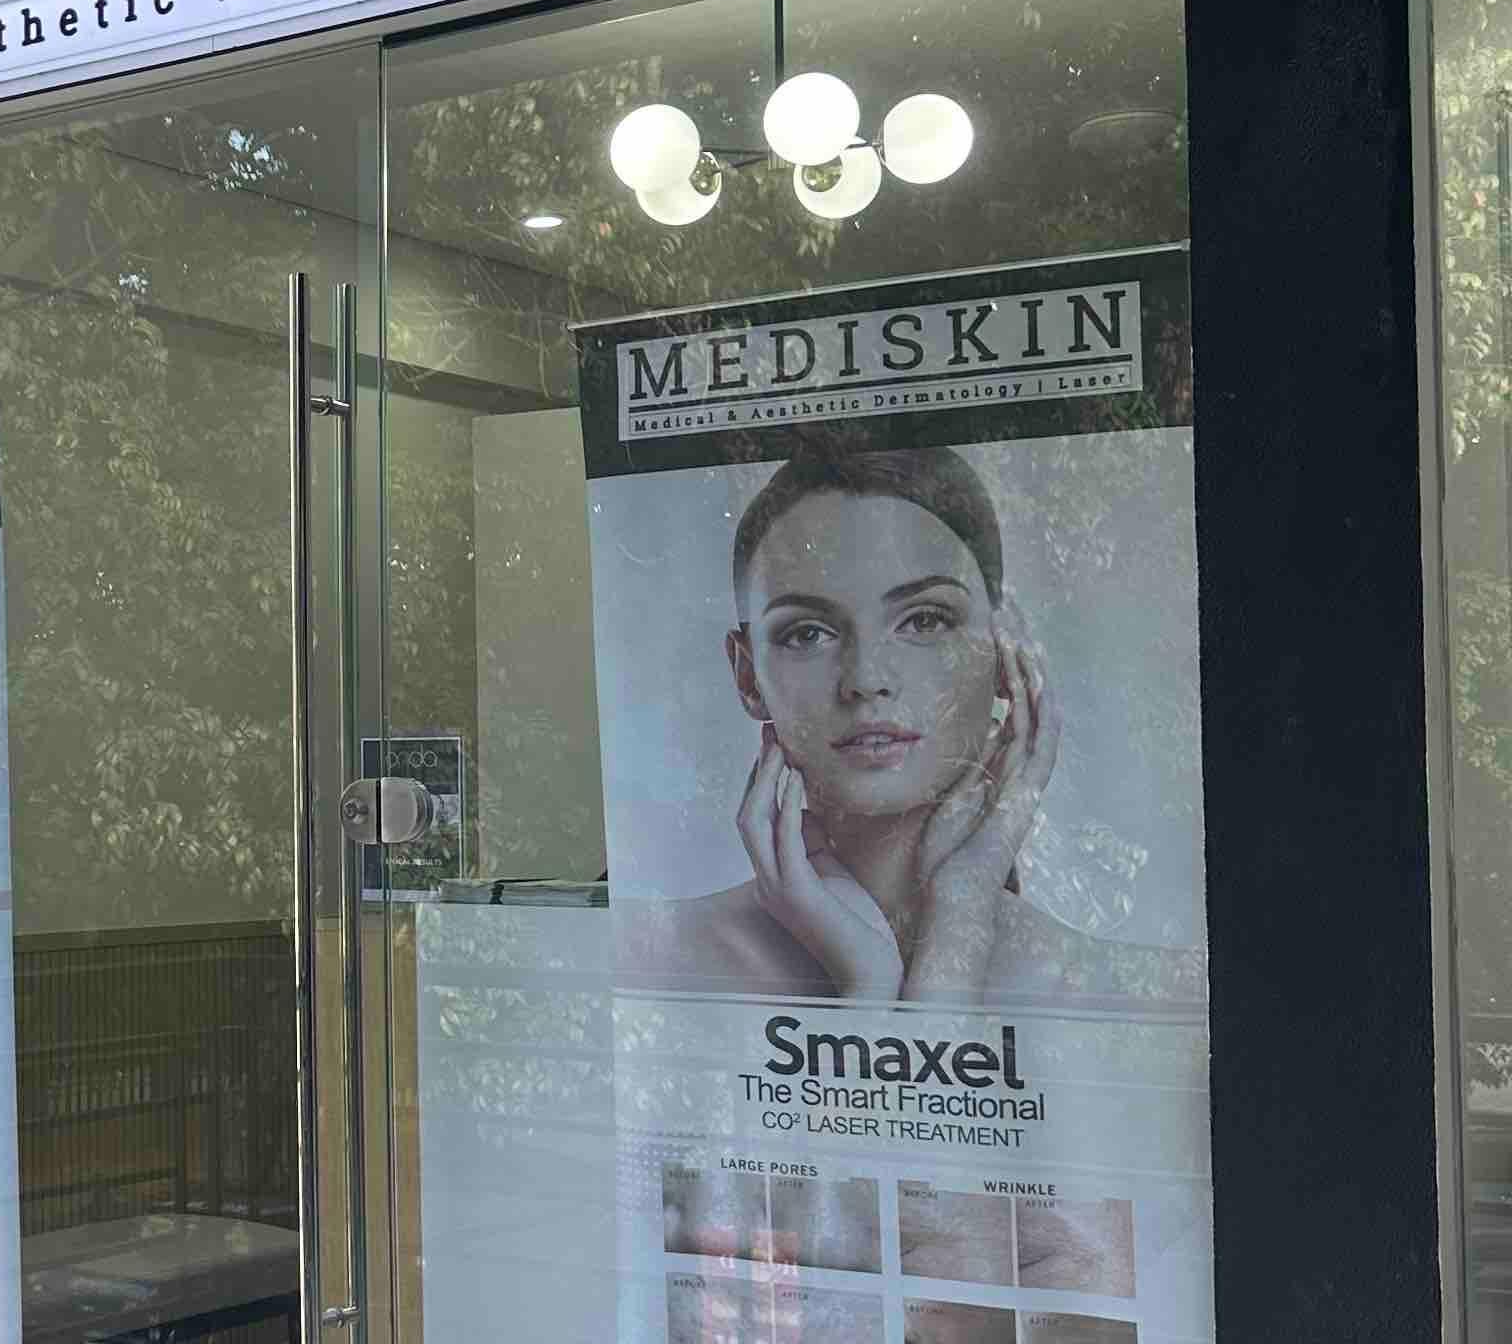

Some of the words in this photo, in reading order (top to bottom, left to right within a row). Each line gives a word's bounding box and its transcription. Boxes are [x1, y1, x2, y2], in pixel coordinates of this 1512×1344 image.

[628, 289, 1126, 400] MEDISKIN
[634, 411, 715, 432] Medical
[751, 397, 860, 420] Aesthetic
[873, 382, 1022, 407] Dermatology
[1058, 372, 1128, 390] Laser
[764, 1015, 1025, 1090] Smaxel
[737, 1073, 792, 1104] The
[800, 1079, 889, 1112] Smart
[897, 1084, 1046, 1121] Fractional
[807, 1114, 881, 1137] LASER
[885, 1119, 1025, 1148] TREATMENT
[720, 1157, 765, 1174] LARGE
[770, 1161, 819, 1178] PORES
[983, 1179, 1057, 1197] WRINKLE
